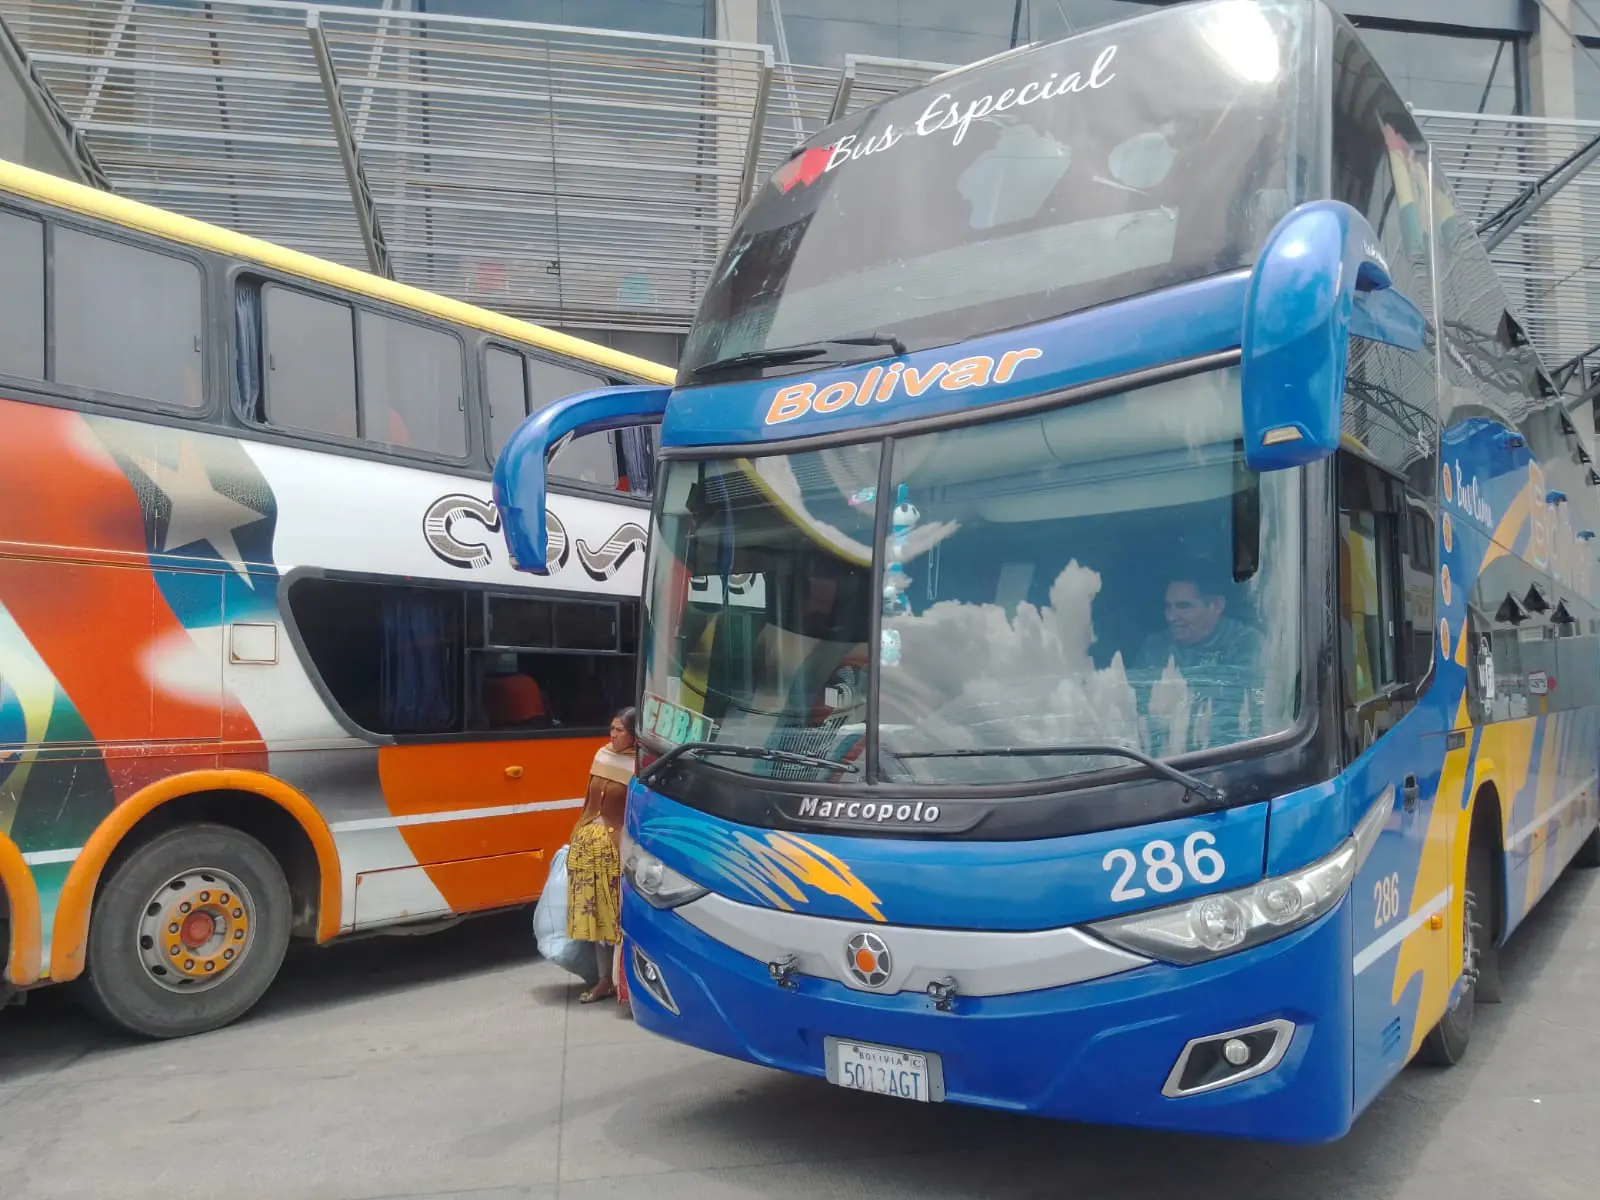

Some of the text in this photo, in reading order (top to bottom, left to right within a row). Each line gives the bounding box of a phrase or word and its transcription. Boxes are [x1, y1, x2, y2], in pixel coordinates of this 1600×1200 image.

[824, 45, 1118, 172] Bus Especial
[765, 347, 1043, 425] Bolivar
[799, 797, 940, 823] Marcopolo
[1102, 831, 1226, 902] 286
[1374, 872, 1399, 929] 286
[859, 1051, 903, 1066] BOLIVIA
